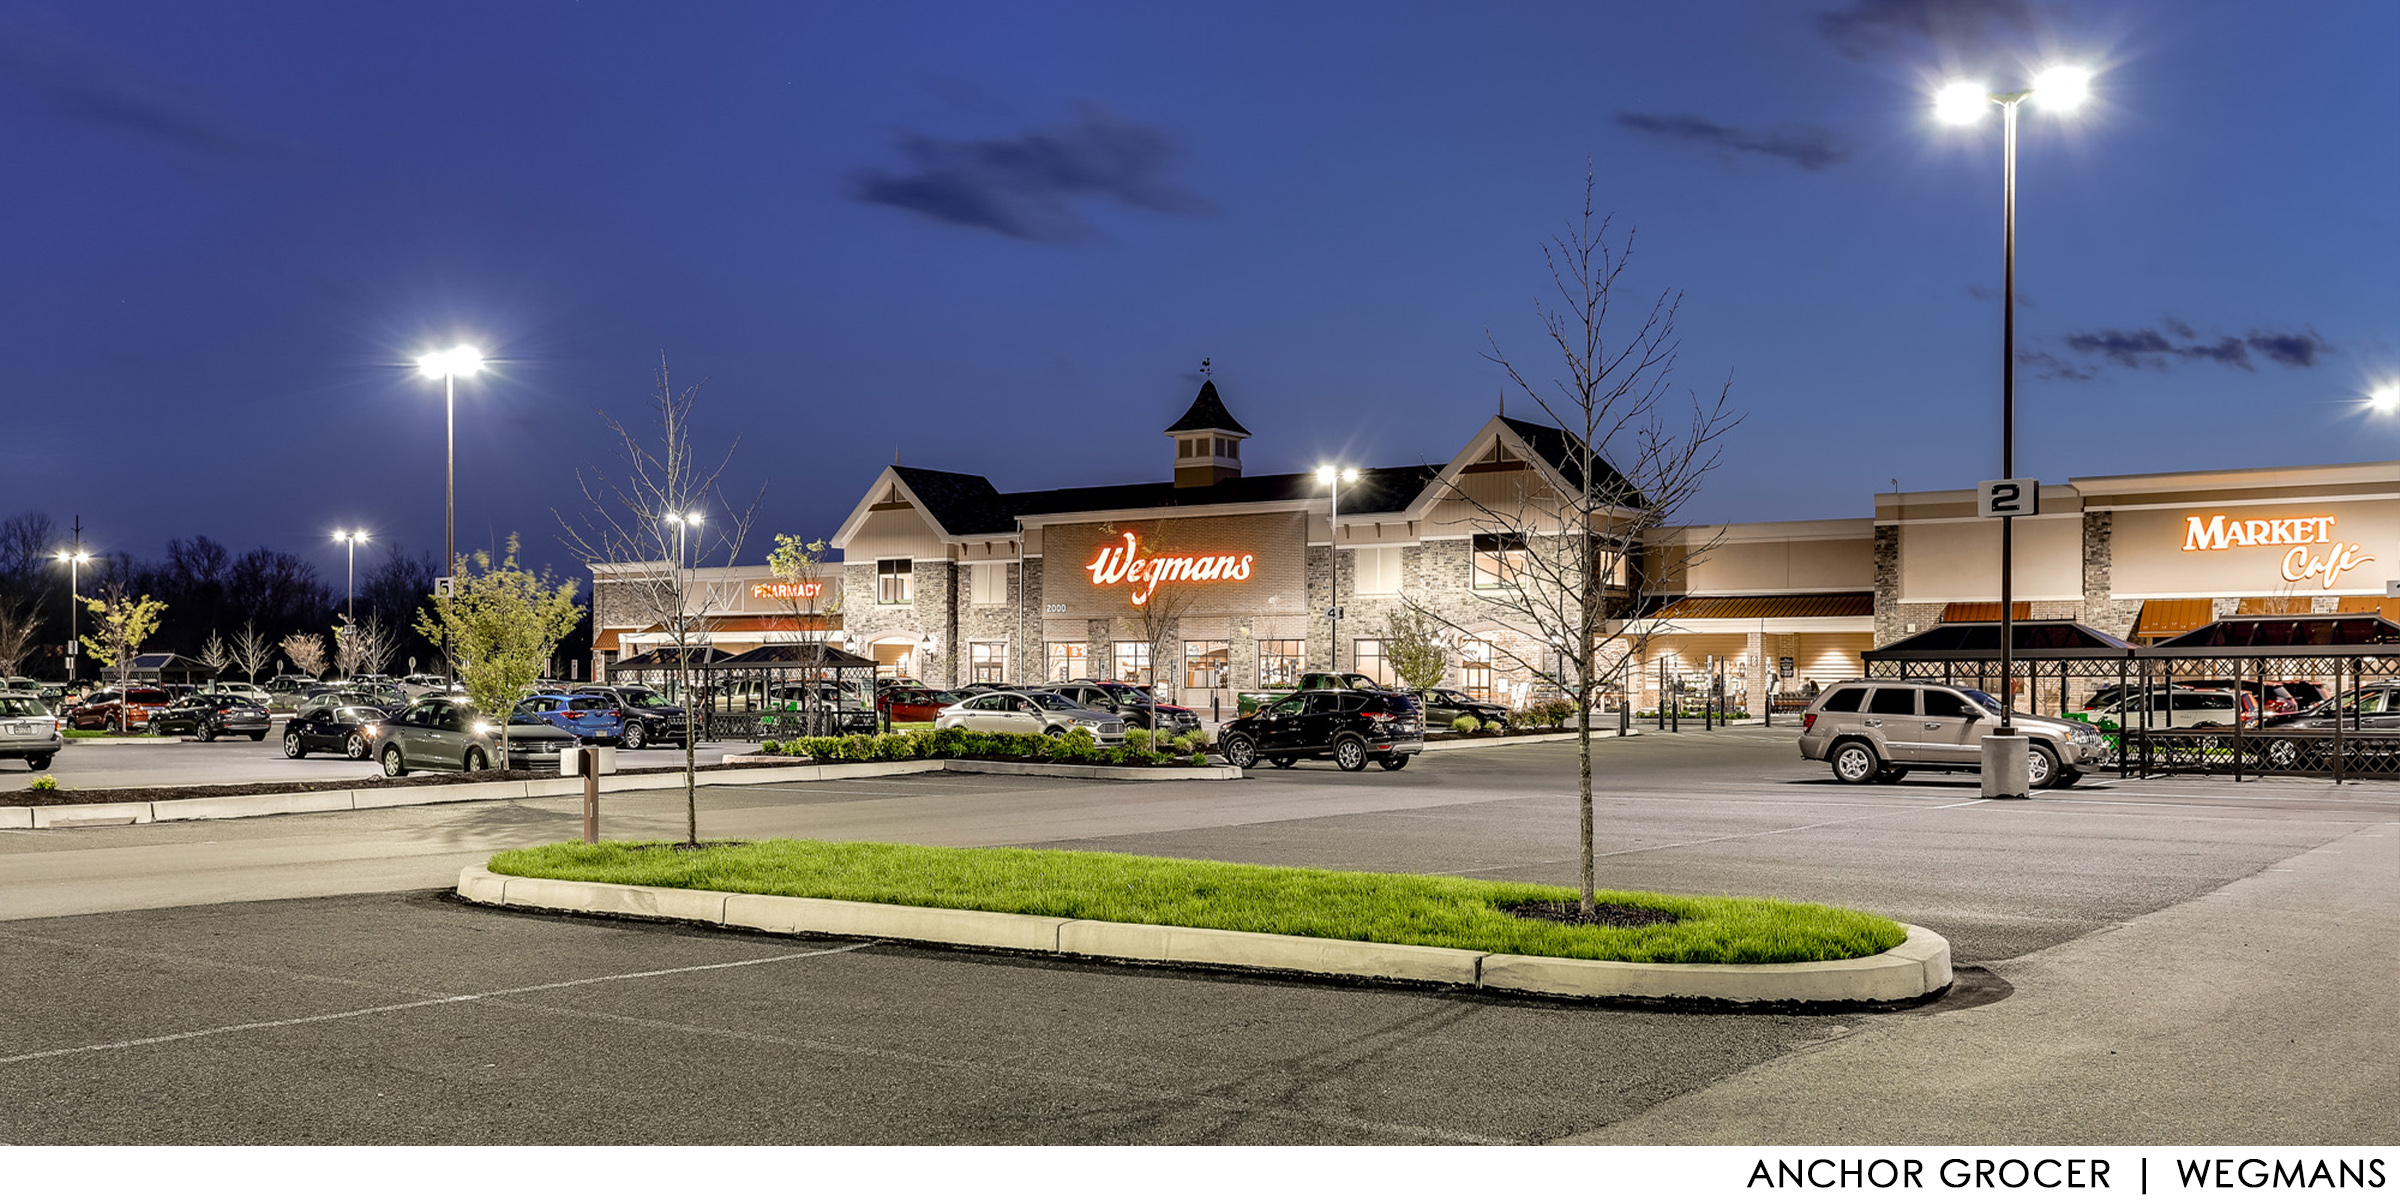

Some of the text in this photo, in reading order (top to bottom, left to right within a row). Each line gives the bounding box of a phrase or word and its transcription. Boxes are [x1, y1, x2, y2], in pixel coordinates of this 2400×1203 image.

[1991, 484, 2020, 512] 2
[2181, 515, 2336, 550] MARKET
[1085, 531, 1254, 606] Wegmans
[2281, 542, 2376, 589] Café
[440, 580, 450, 596] 5
[753, 583, 823, 599] PHARMACY
[1046, 603, 1067, 613] 2000
[1327, 608, 1336, 618] 4
